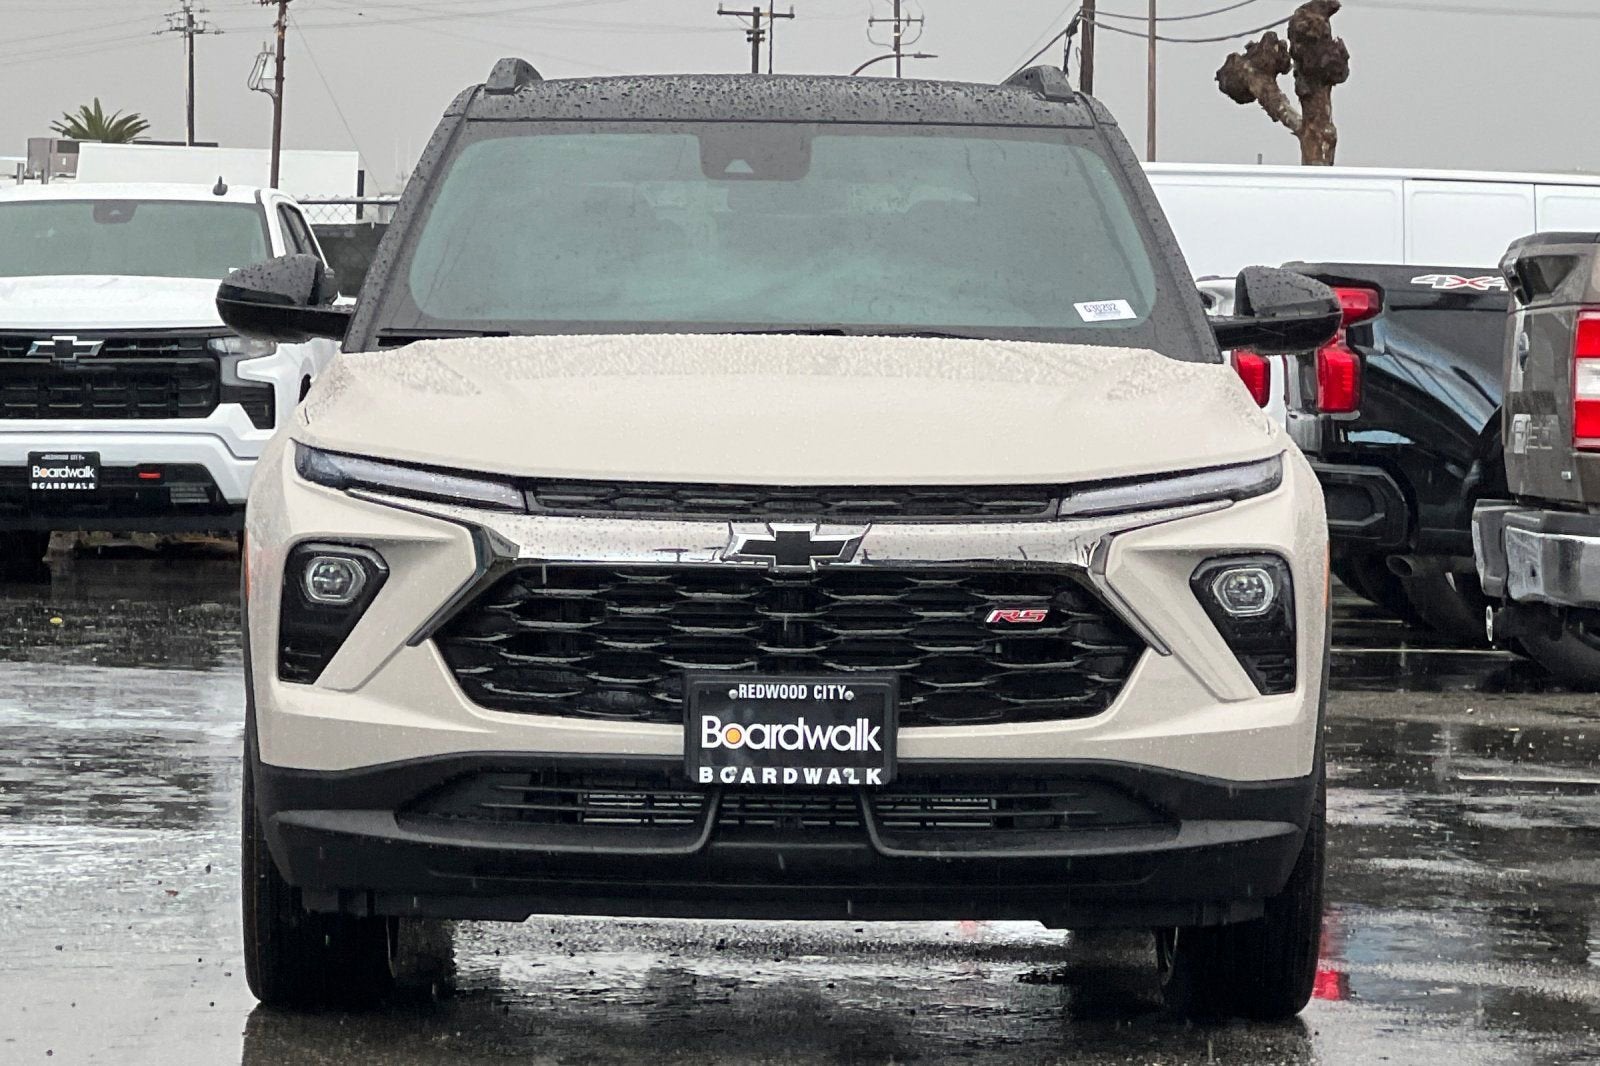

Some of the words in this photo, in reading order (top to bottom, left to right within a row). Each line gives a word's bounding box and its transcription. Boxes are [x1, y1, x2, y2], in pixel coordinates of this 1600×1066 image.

[32, 465, 95, 478] Boardwalk
[986, 609, 1048, 623] RS
[738, 683, 808, 699] REDWOOD
[813, 685, 847, 700] CITY
[701, 715, 882, 752] Boardwalk
